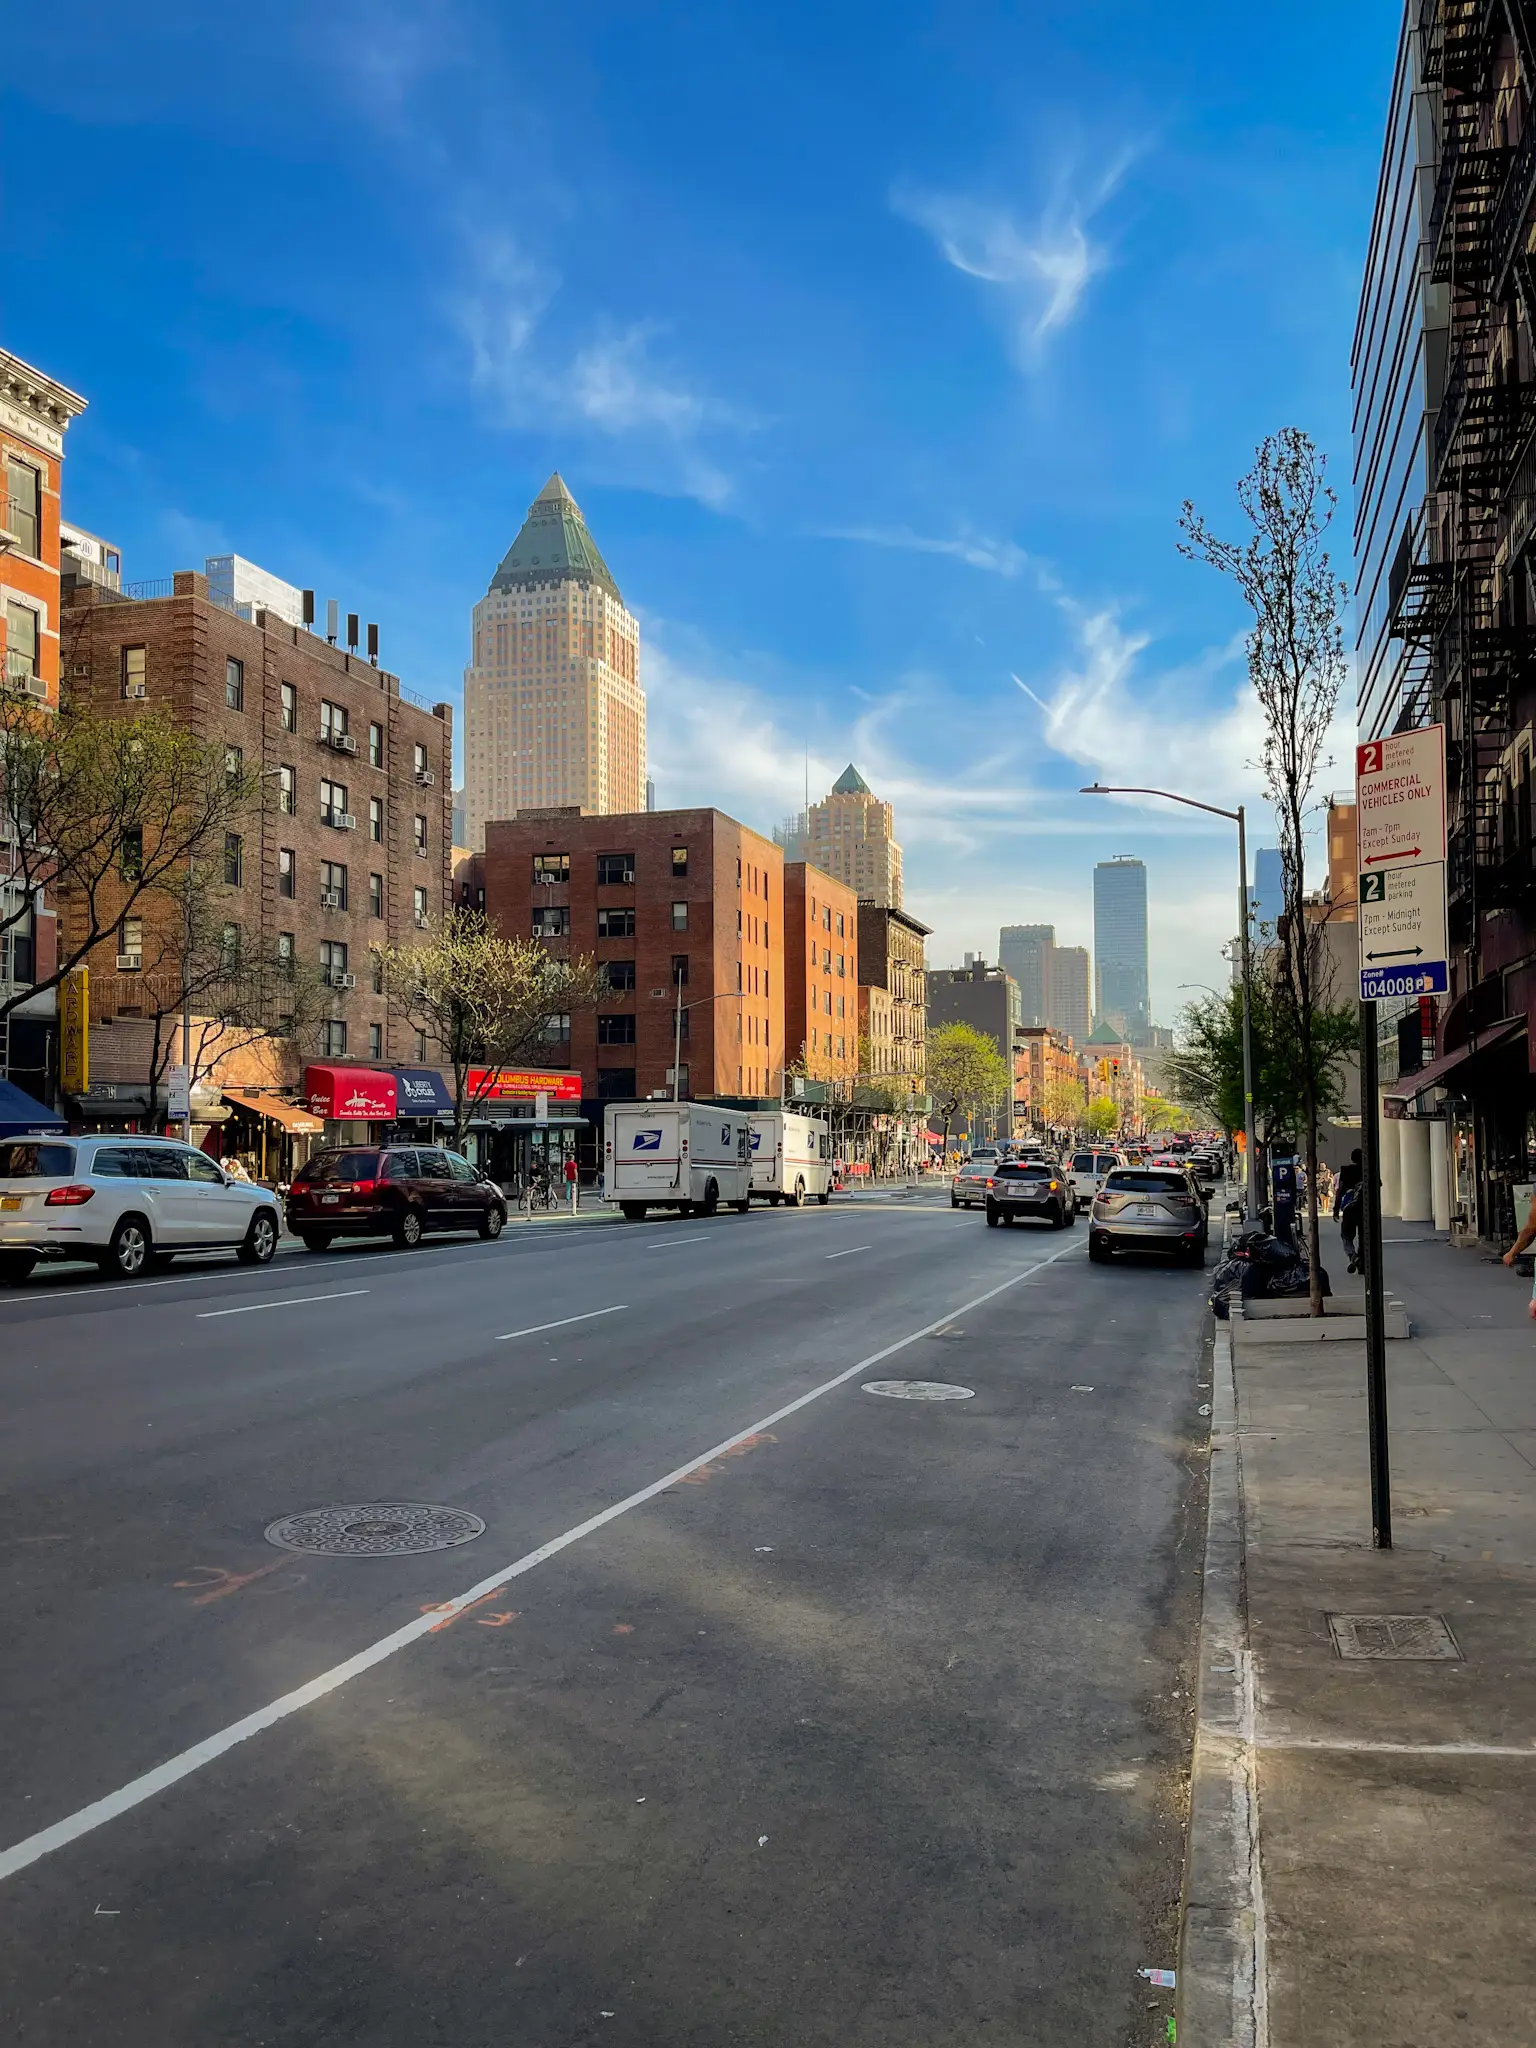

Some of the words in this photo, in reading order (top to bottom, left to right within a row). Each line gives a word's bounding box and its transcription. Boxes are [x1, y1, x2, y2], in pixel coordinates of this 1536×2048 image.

[1385, 742, 1401, 751] hour
[1385, 746, 1415, 761] metered
[1363, 746, 1377, 773] 2
[1385, 758, 1411, 771] parking
[1361, 773, 1421, 797] COMMERCIAL
[1362, 791, 1405, 810] VEHICLES
[1407, 785, 1432, 800] ONLY
[1362, 827, 1378, 837] 7am
[1384, 823, 1401, 835] 7pm
[1362, 835, 1389, 850] Except
[1391, 830, 1421, 844] Sunday
[1387, 872, 1403, 881] hour
[1365, 874, 1379, 901] 2
[1387, 878, 1416, 890] metered
[1388, 890, 1413, 901] parking
[1363, 914, 1380, 925] 7pm
[1387, 906, 1421, 921] Midnight
[1363, 923, 1390, 936] Except
[1392, 920, 1422, 933] Sunday
[1362, 969, 1384, 979] Zone#
[1363, 976, 1414, 998] 104008
[65, 970, 79, 1076] HARDWARE
[491, 1073, 529, 1085] COLUMBUS
[530, 1075, 564, 1086] HARDWARE
[311, 1094, 331, 1103] Juice
[312, 1105, 329, 1115] Bar
